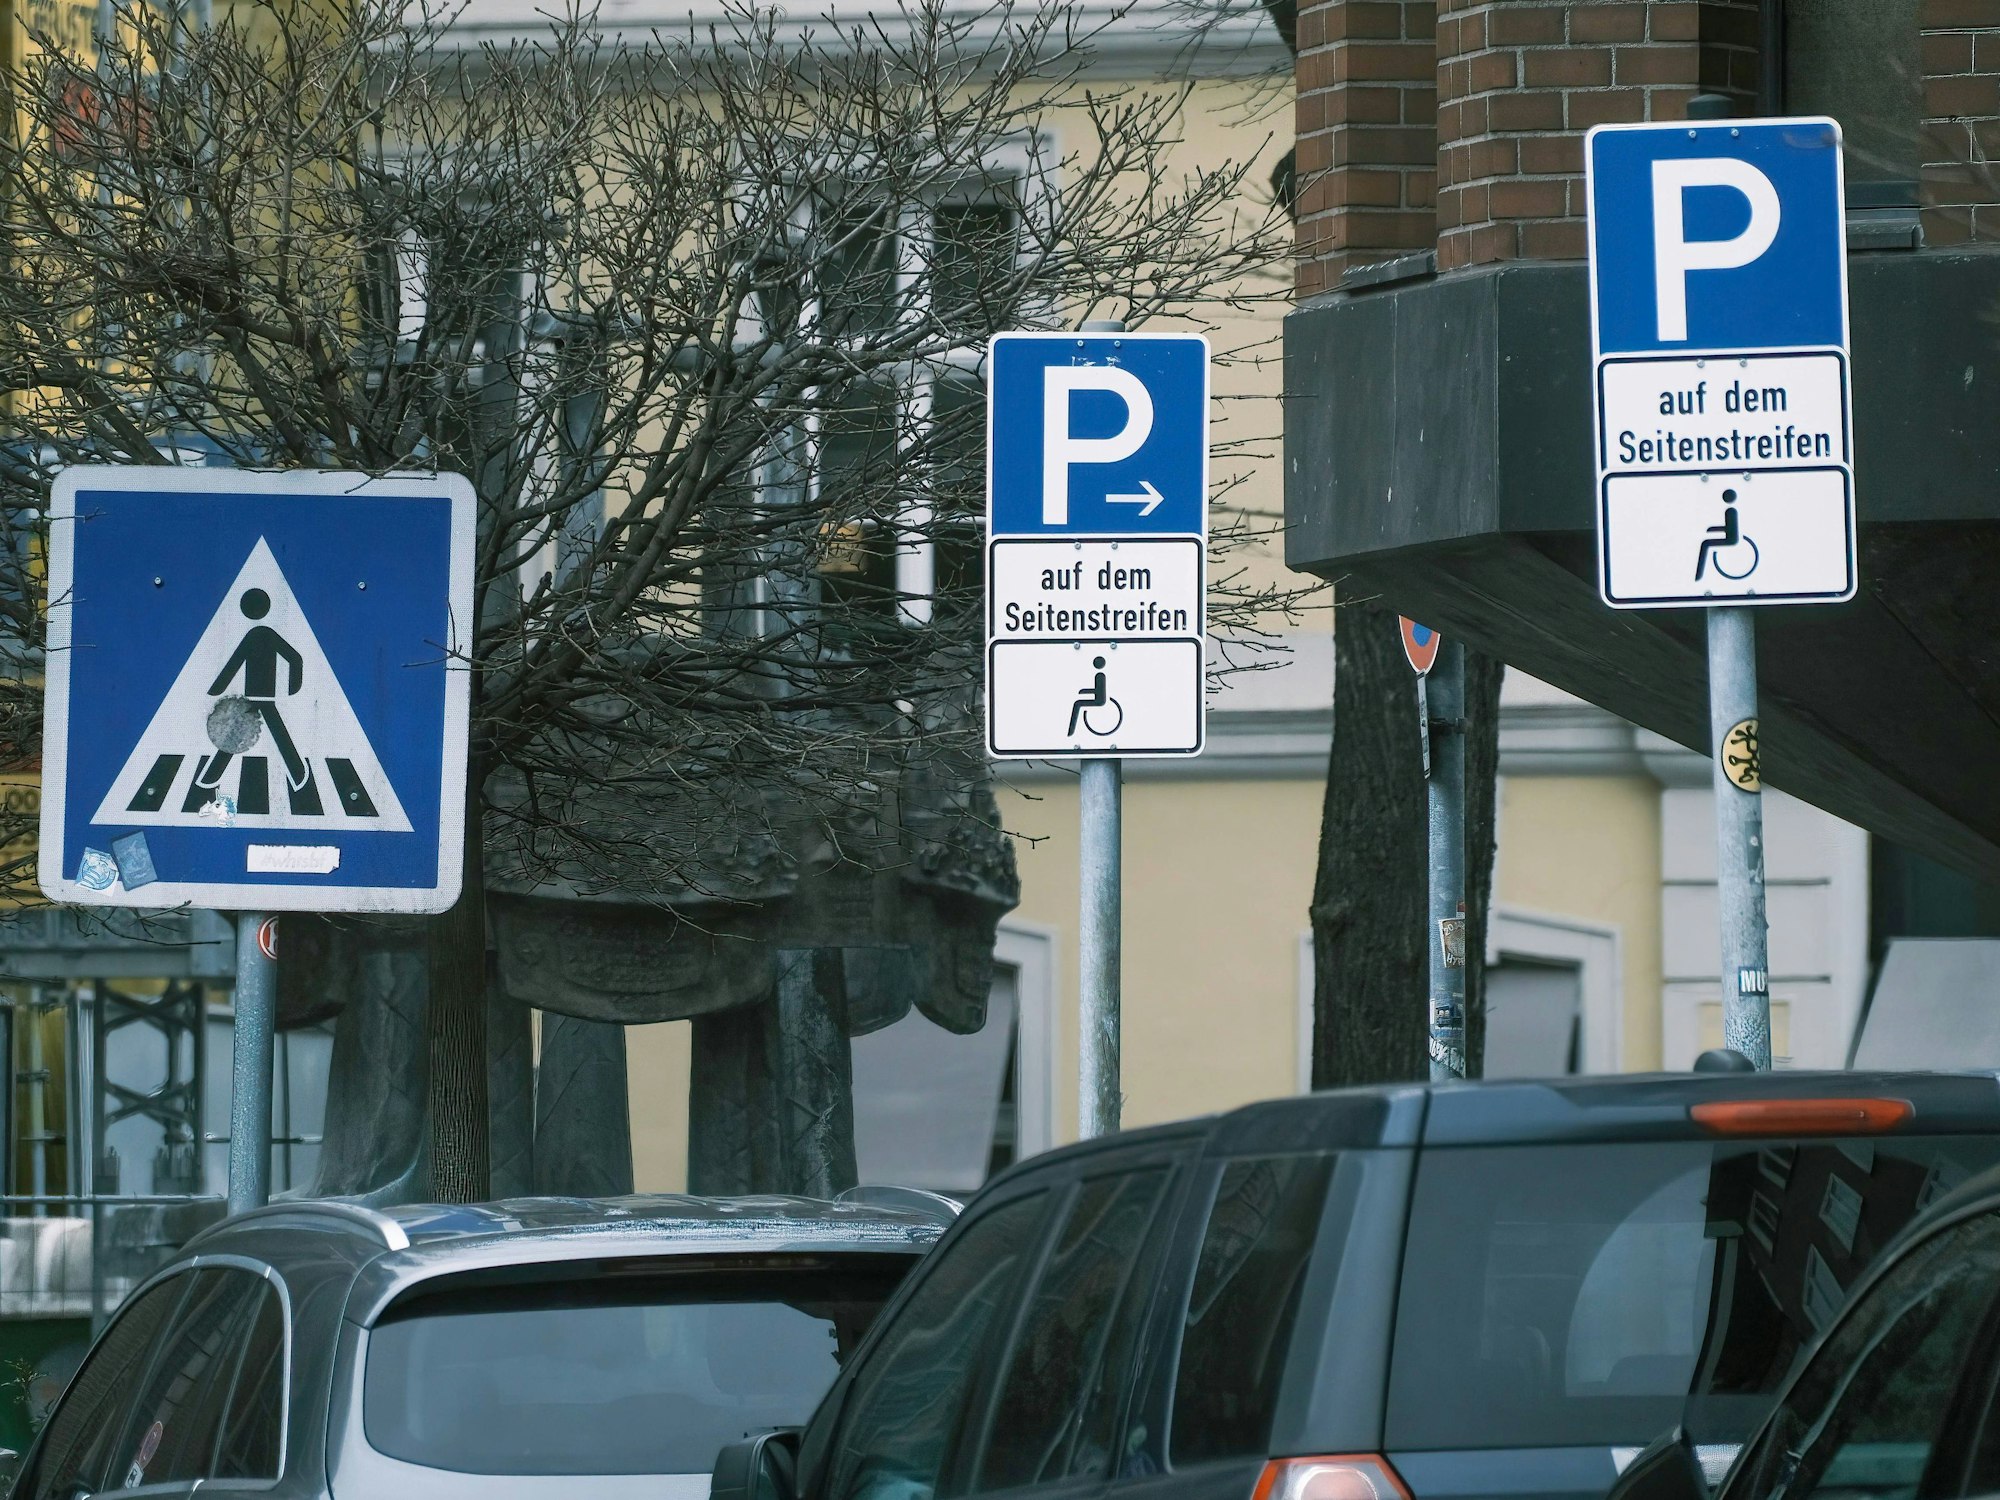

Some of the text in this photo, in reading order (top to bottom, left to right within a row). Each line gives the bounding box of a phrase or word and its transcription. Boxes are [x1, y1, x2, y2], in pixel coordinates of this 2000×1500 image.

[1652, 157, 1781, 342] P
[1659, 380, 1787, 415] auf dem
[1043, 366, 1154, 525] P
[1619, 425, 1831, 464] Seitenstreifen
[1041, 561, 1151, 590] auf dem
[1005, 601, 1188, 632] Seitenstreifen
